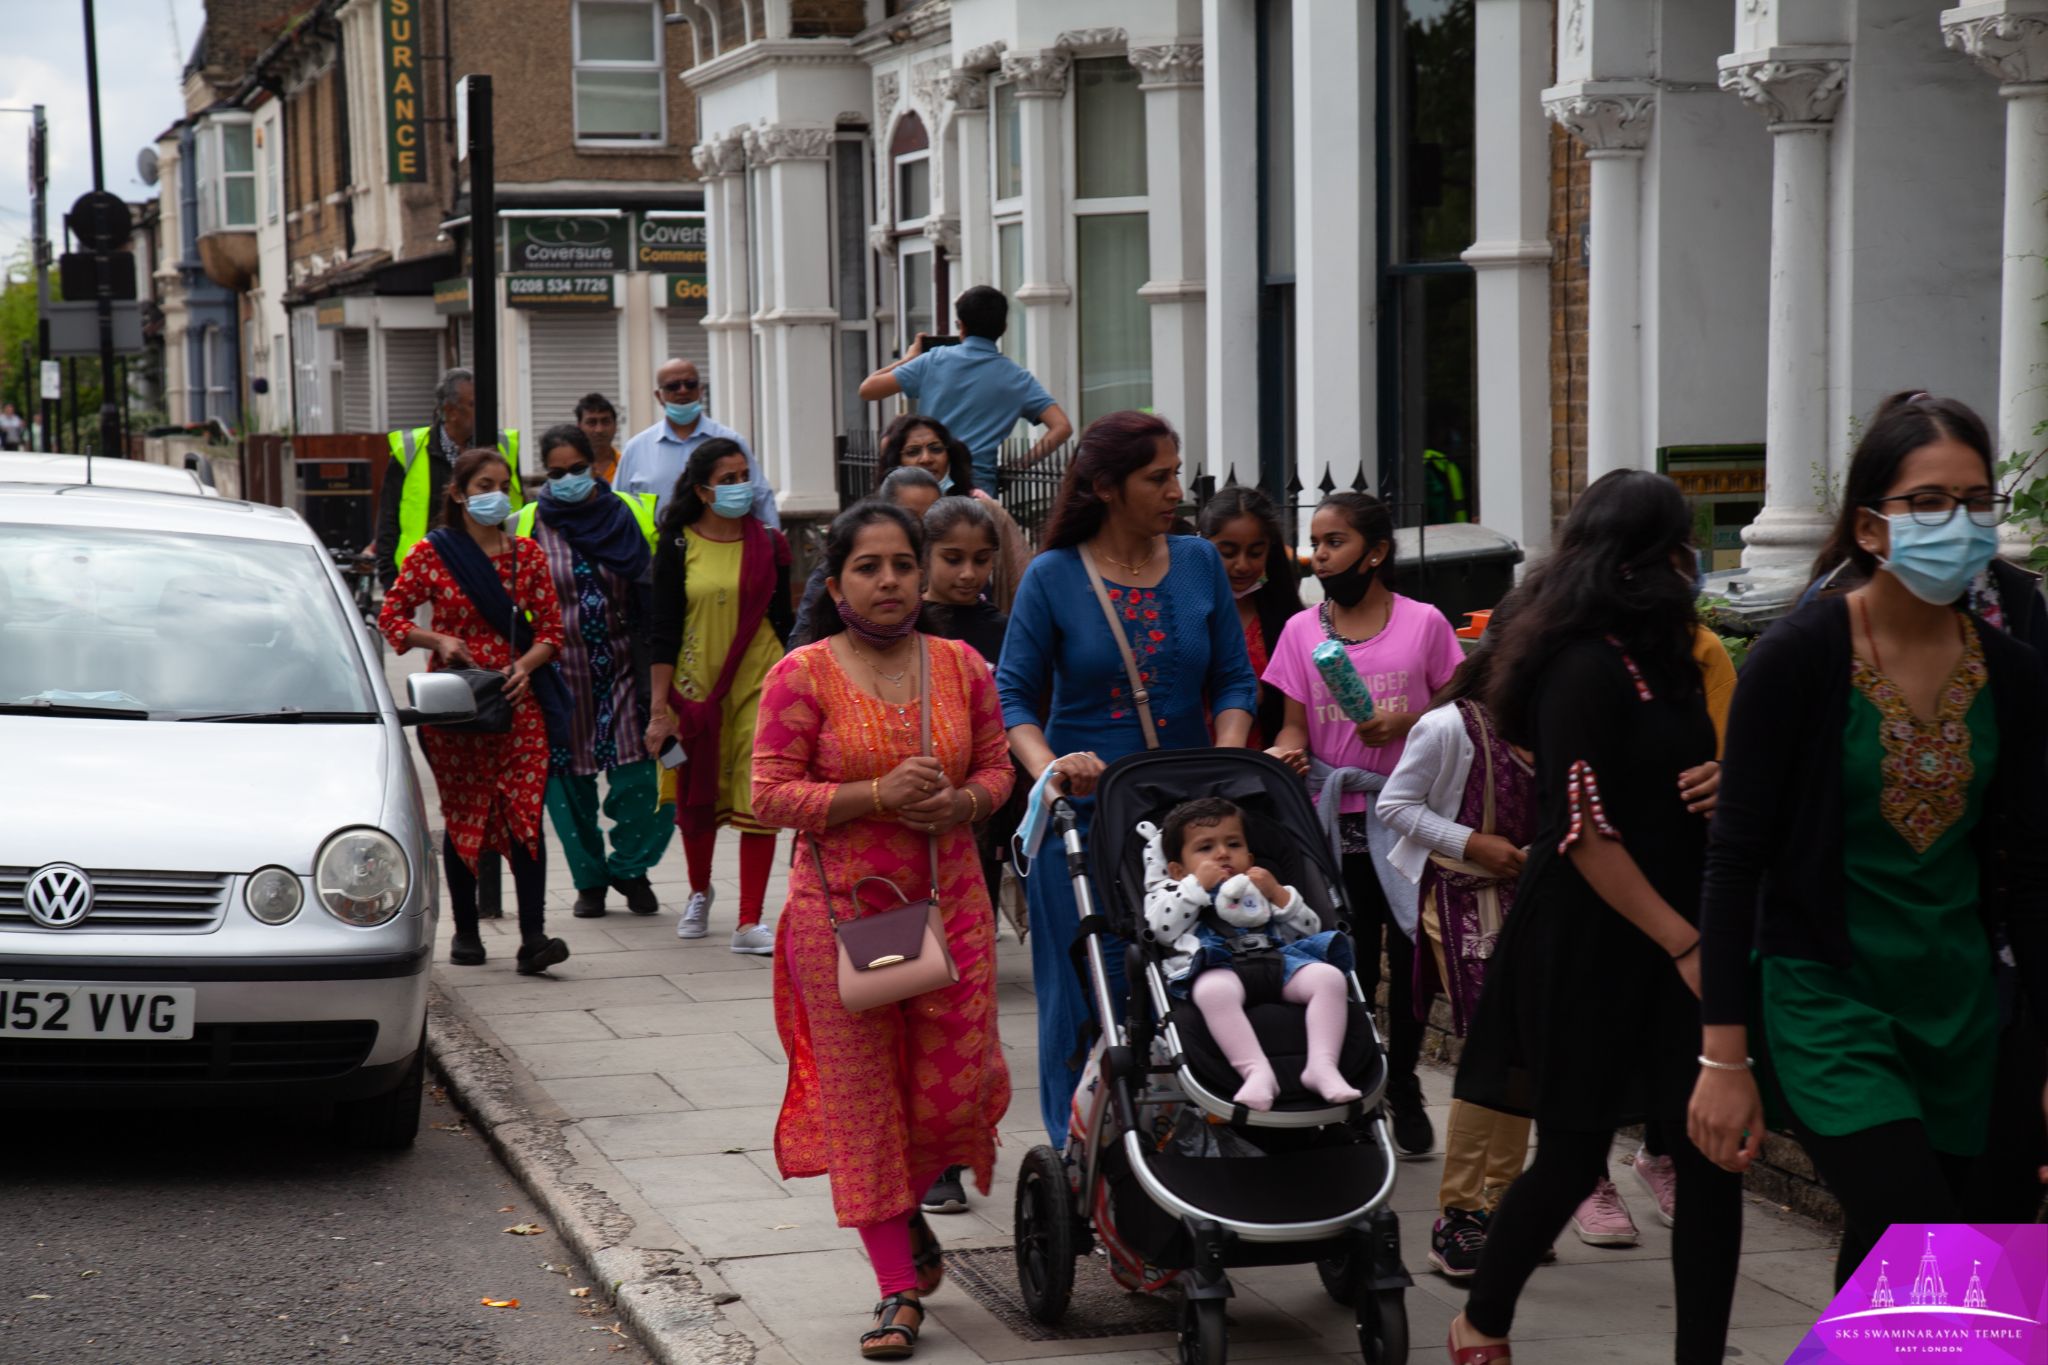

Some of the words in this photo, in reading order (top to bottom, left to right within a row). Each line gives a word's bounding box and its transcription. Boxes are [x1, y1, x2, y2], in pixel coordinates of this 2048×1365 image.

[525, 244, 613, 261] Coversure
[510, 278, 544, 293] 0208
[546, 278, 571, 293] 534
[574, 278, 608, 293] 7726
[89, 993, 176, 1033] VVG
